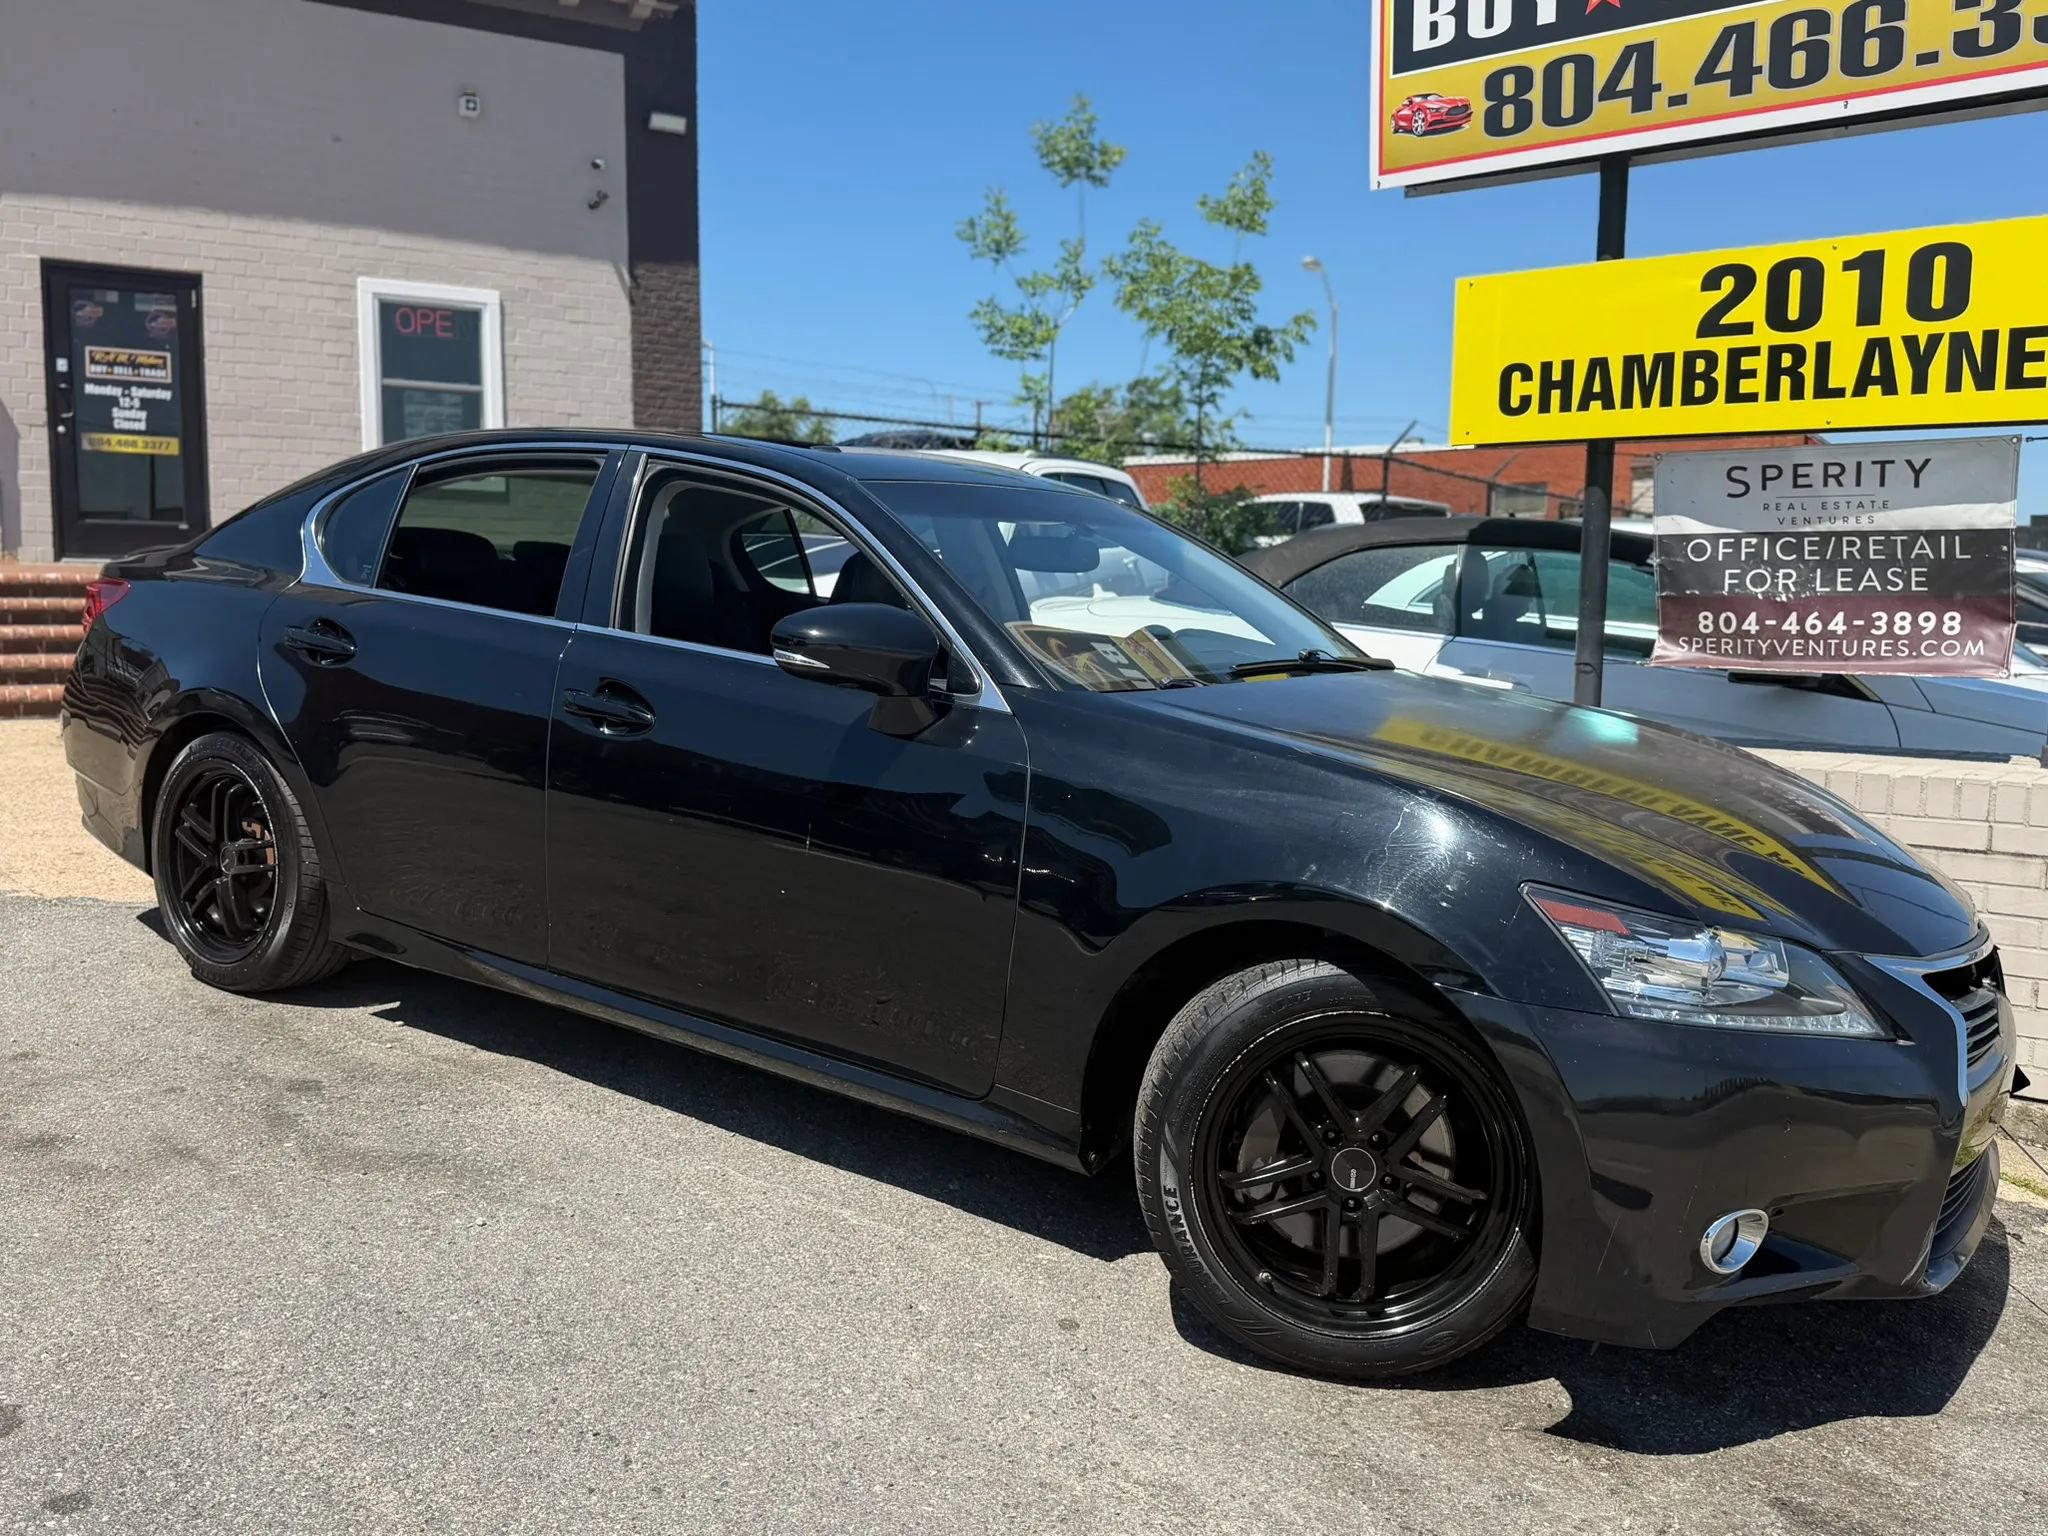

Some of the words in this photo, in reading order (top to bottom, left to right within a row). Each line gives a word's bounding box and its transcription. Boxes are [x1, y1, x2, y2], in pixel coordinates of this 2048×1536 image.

[1483, 0, 2048, 136] 804.466.3
[1696, 241, 1973, 338] 2010
[1498, 325, 2048, 417] CHAMBERLAYNE
[1726, 458, 1932, 499] SPERITY
[1763, 500, 1807, 512] REAL
[1821, 500, 1889, 510] ESTATE
[1777, 515, 1875, 526] VENTURES
[1687, 535, 1972, 562] OFFICE/RETAIL
[1723, 568, 1797, 593] FOR
[1816, 568, 1929, 592] LEASE
[1698, 611, 1962, 635] 804-464-3898
[1678, 637, 1985, 658] SPERITYVENTURES.COM
